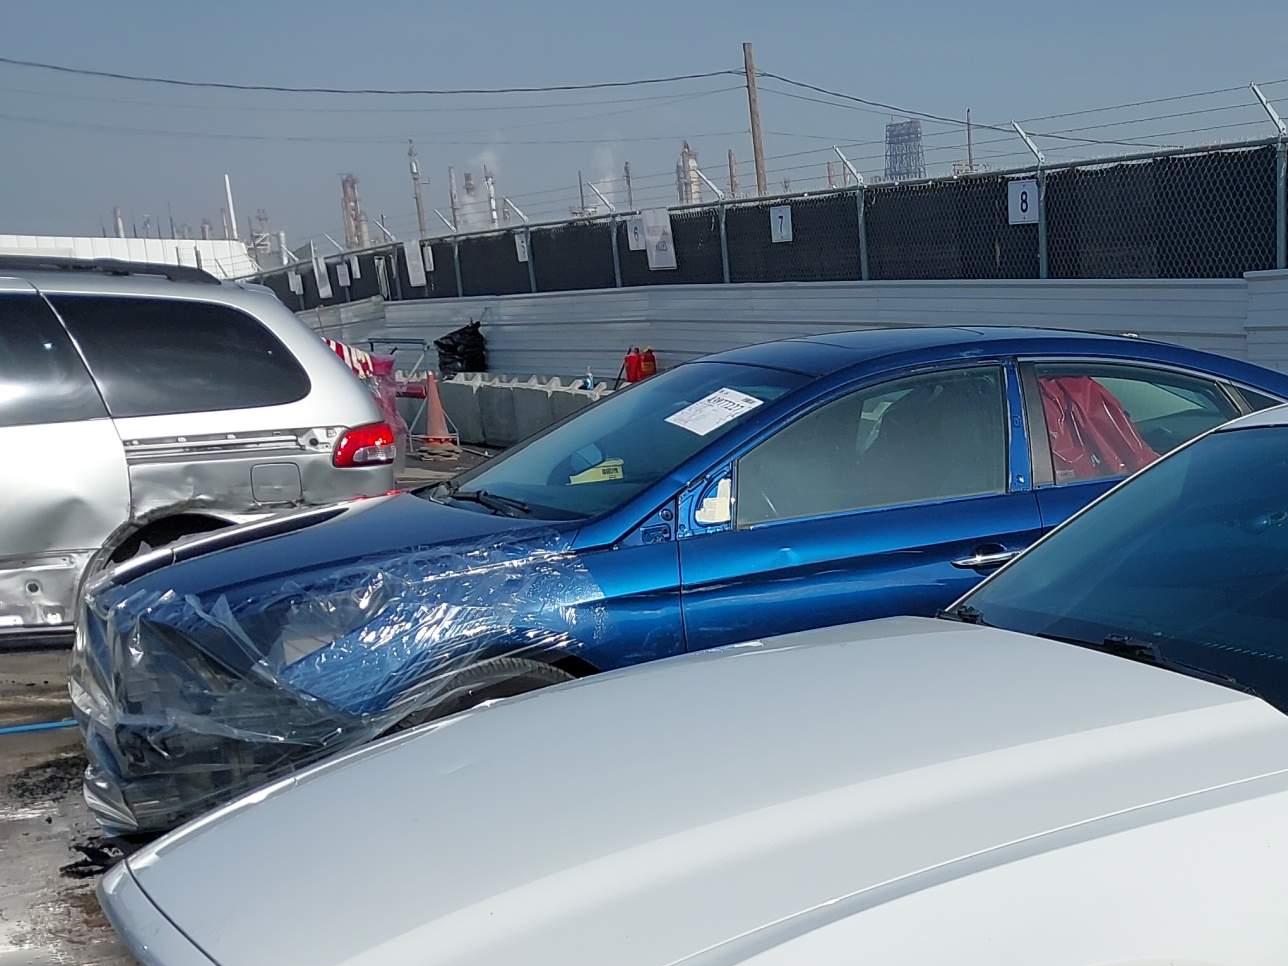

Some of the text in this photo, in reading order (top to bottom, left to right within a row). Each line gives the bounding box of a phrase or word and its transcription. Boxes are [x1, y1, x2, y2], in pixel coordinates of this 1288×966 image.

[1021, 191, 1028, 212] 8
[778, 215, 784, 233] 7
[633, 227, 639, 241] 6
